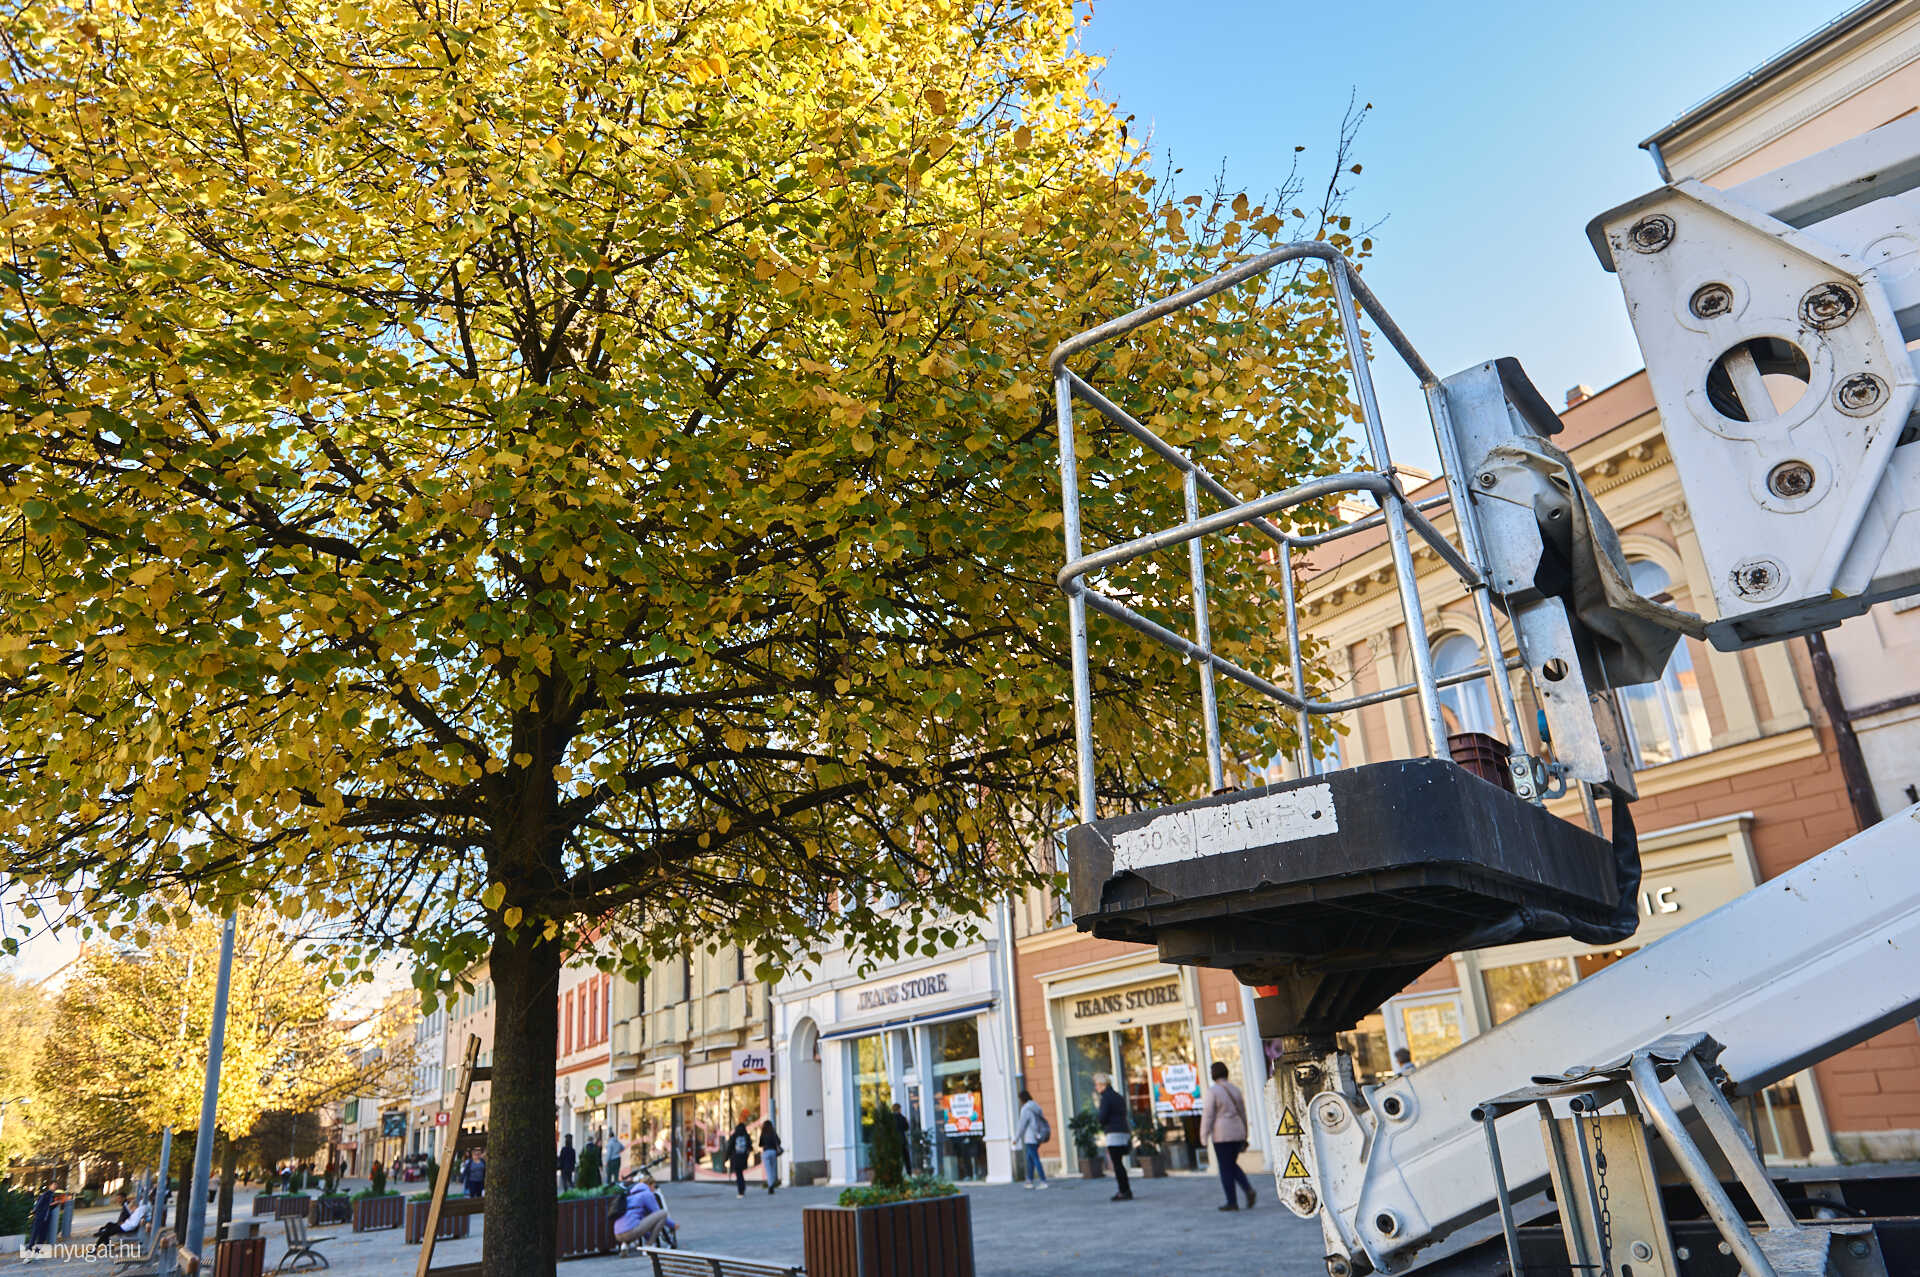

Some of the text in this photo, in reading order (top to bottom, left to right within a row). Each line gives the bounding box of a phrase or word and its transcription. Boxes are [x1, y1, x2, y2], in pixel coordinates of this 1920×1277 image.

[901, 973, 949, 1001] STORE
[1074, 984, 1181, 1018] JEANS STORE
[742, 1054, 764, 1069] dm
